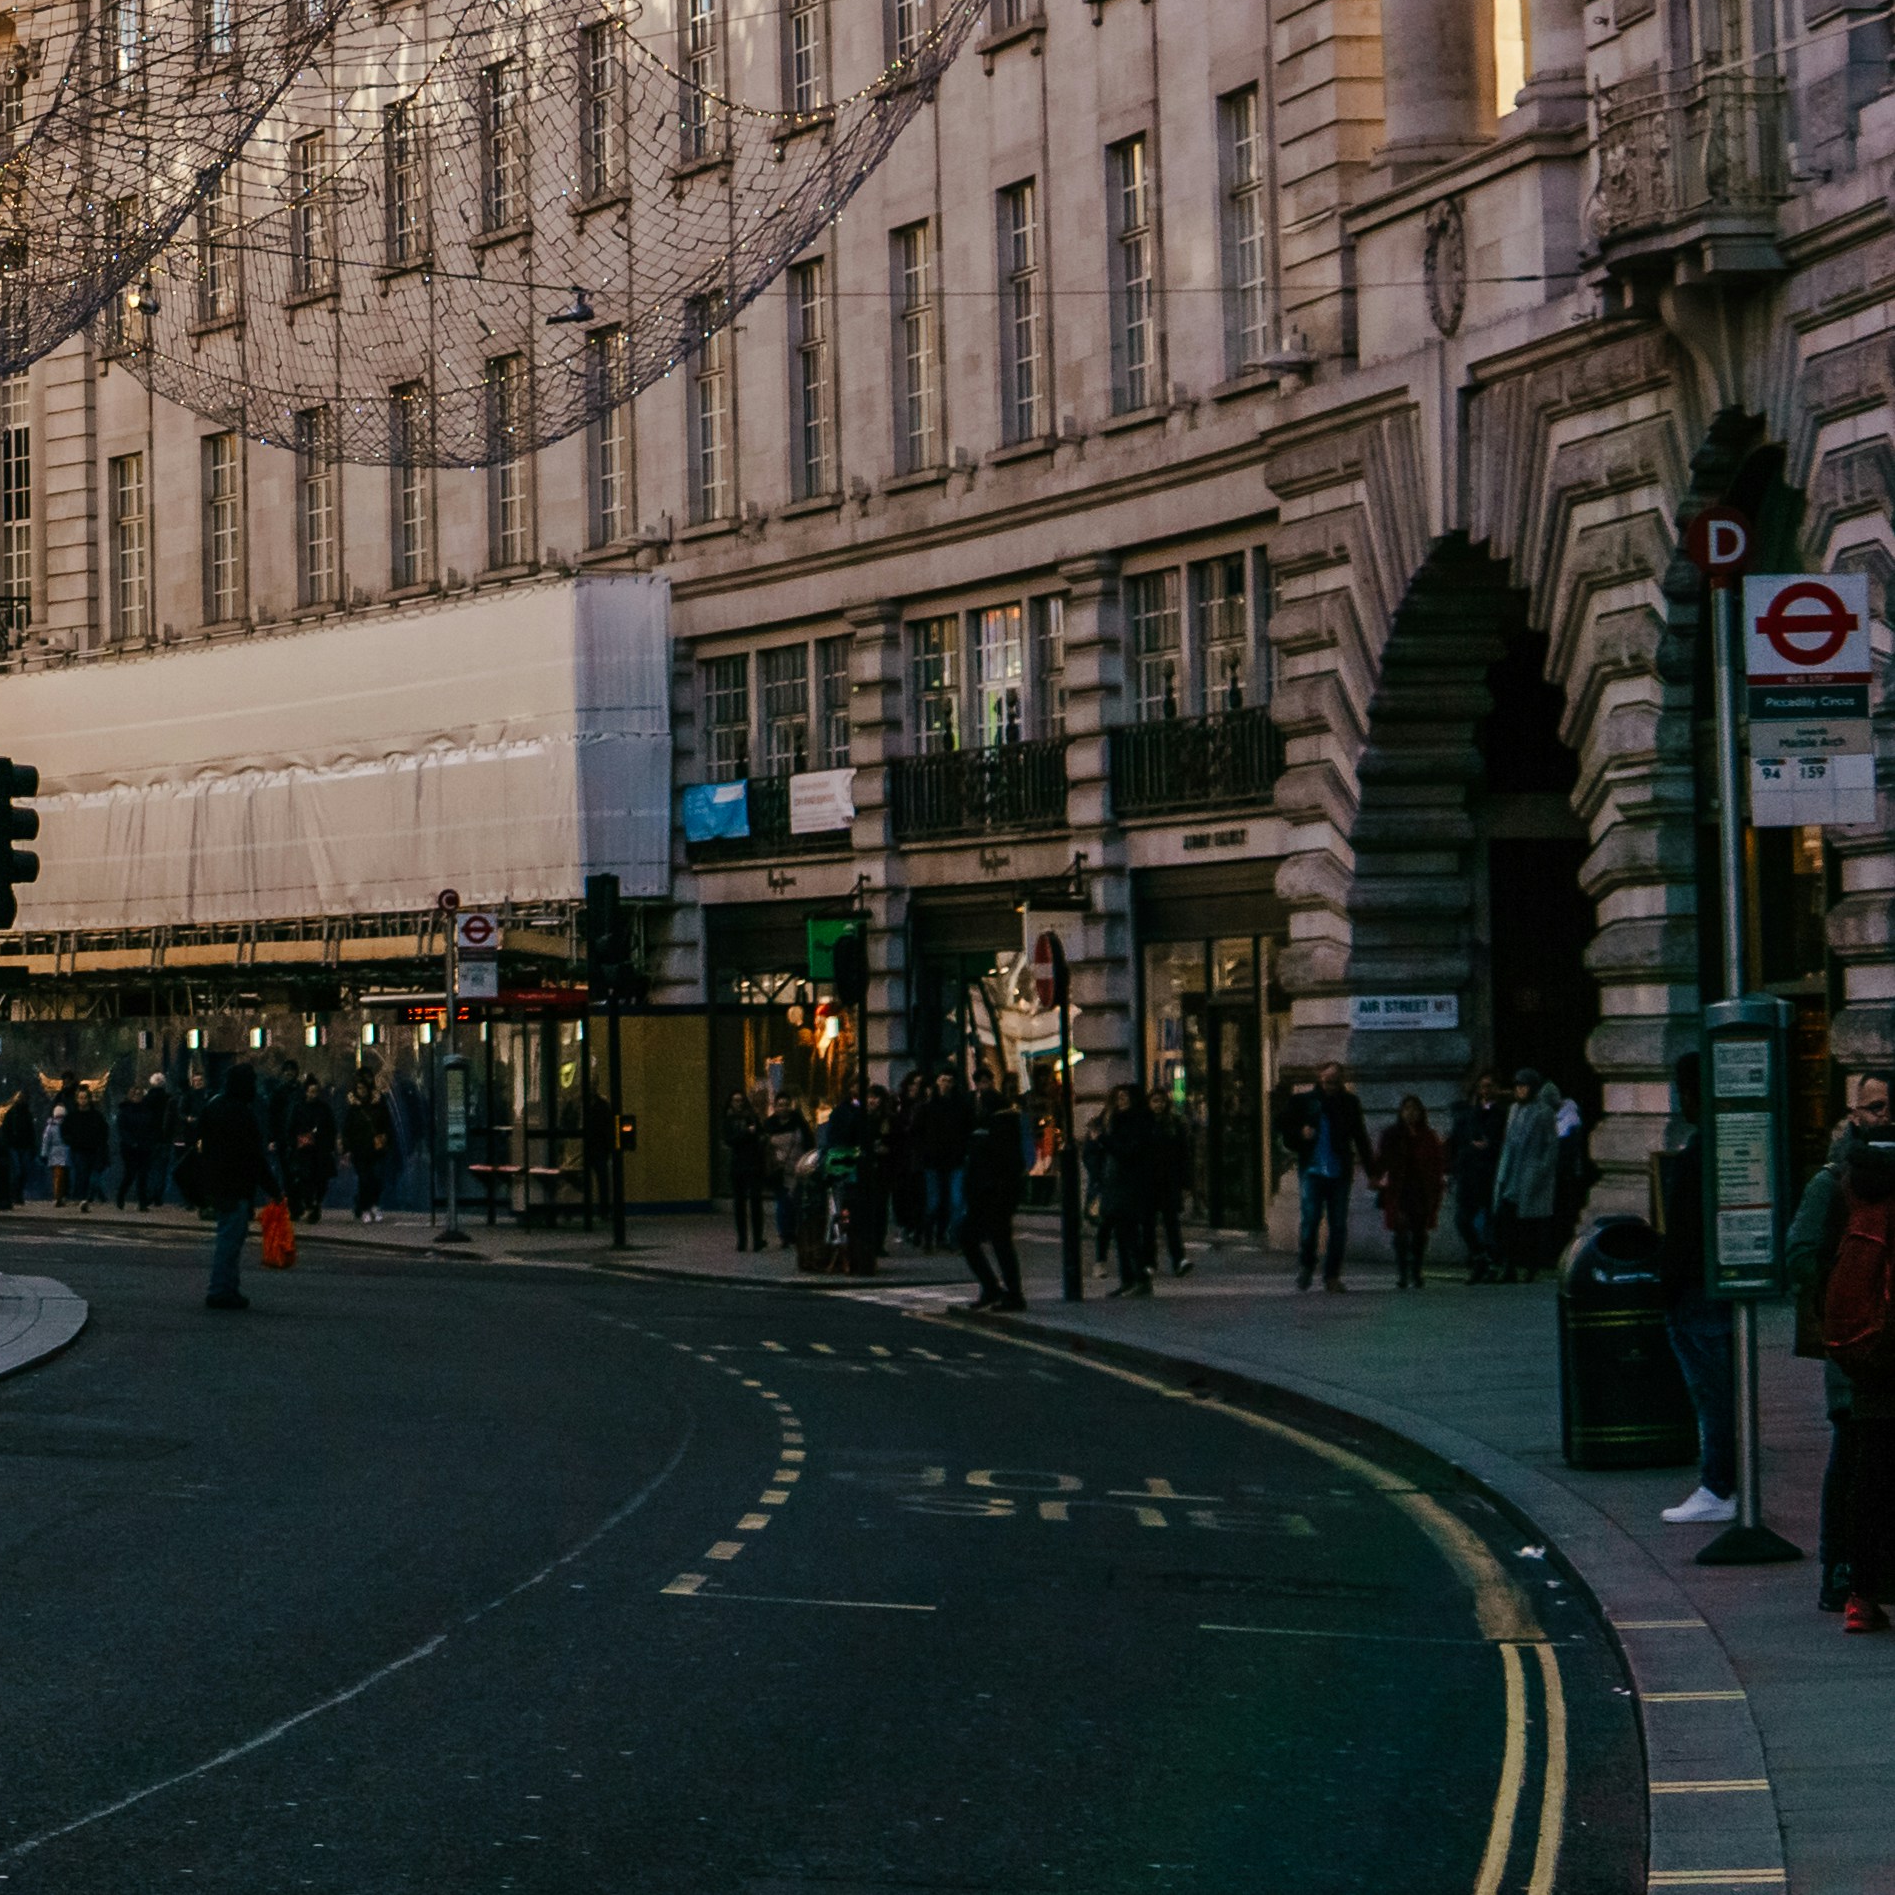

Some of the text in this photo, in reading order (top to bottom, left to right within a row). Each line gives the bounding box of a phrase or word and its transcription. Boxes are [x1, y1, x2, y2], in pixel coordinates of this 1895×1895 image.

[1708, 519, 1746, 564] D
[1765, 695, 1855, 708] Piccadilly Circus
[1762, 766, 1826, 779] 94 159
